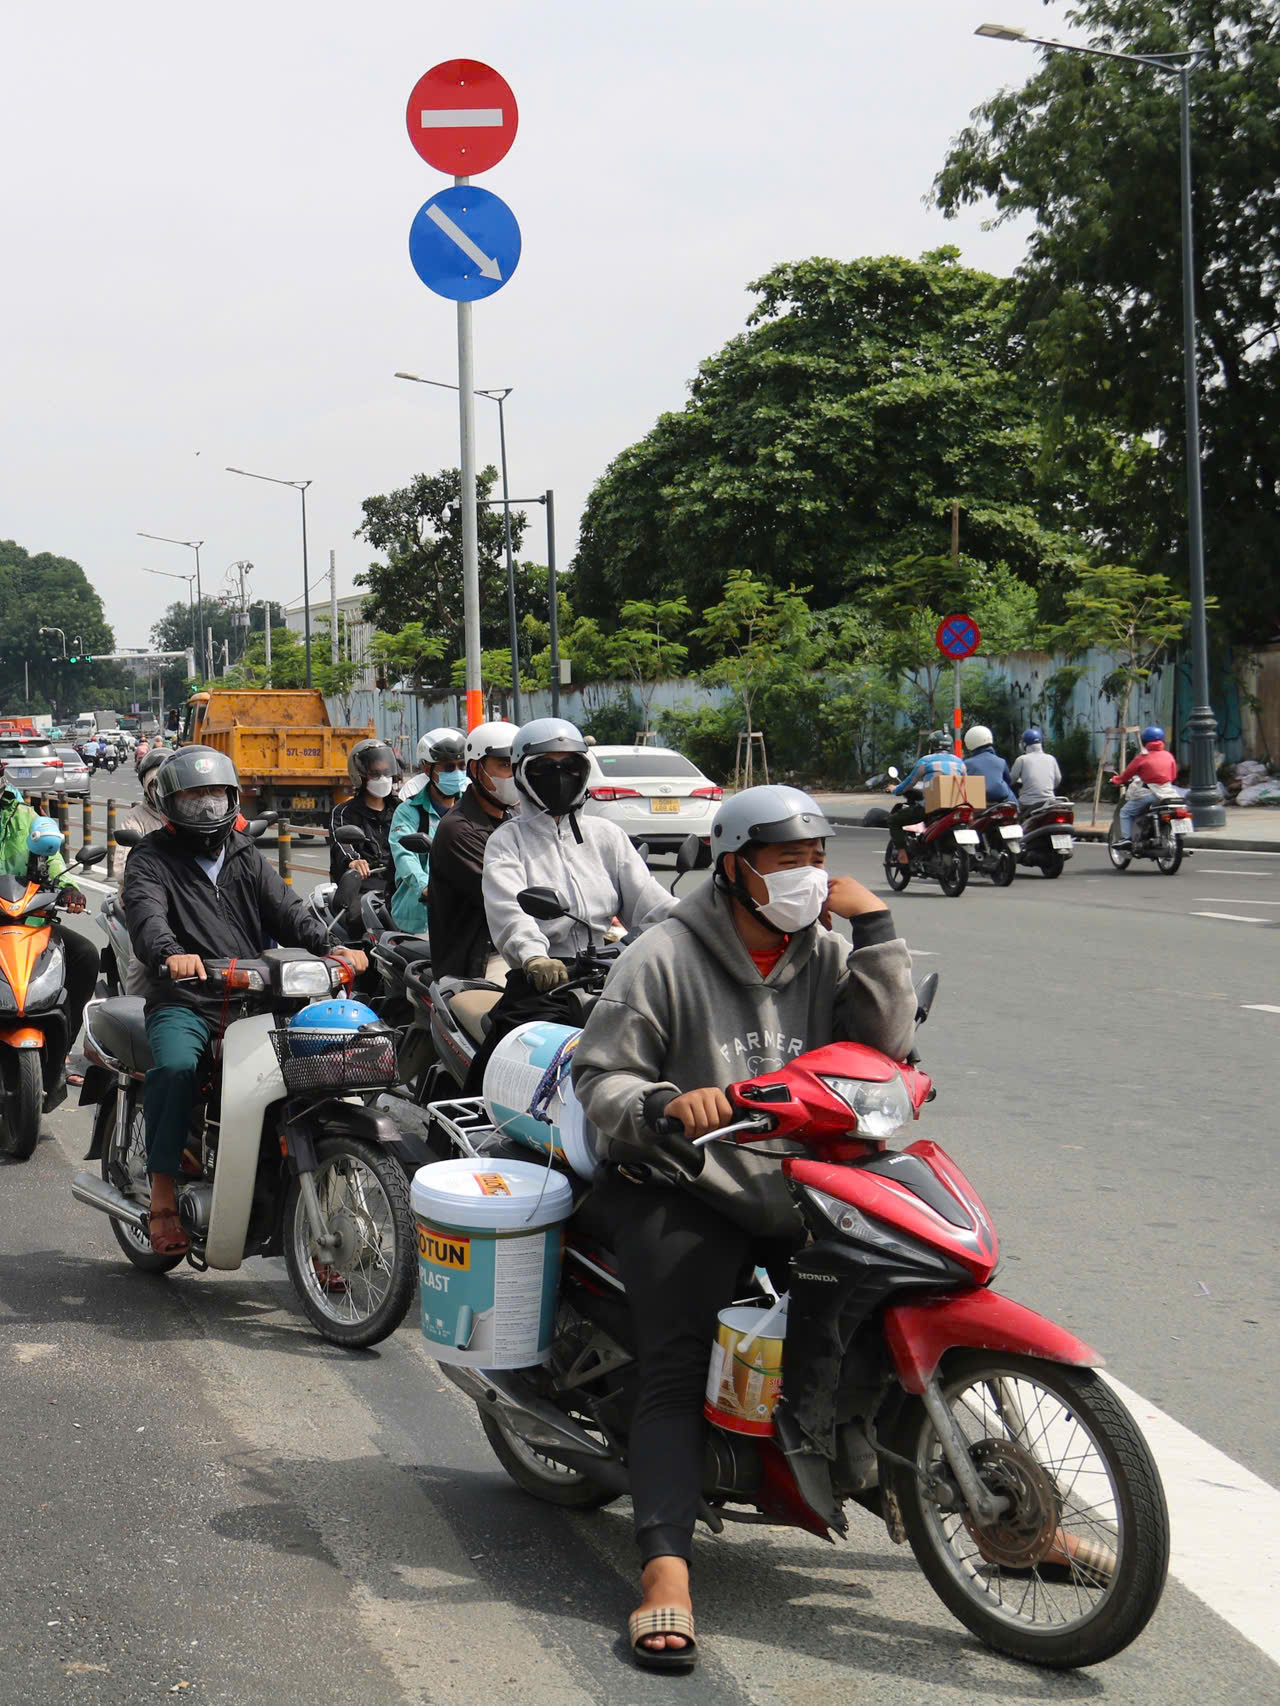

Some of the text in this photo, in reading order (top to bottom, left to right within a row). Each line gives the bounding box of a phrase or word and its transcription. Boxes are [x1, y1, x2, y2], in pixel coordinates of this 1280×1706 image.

[720, 1030, 803, 1063] FARMER
[419, 1233, 465, 1265] OTUN
[798, 1272, 839, 1283] HONDA
